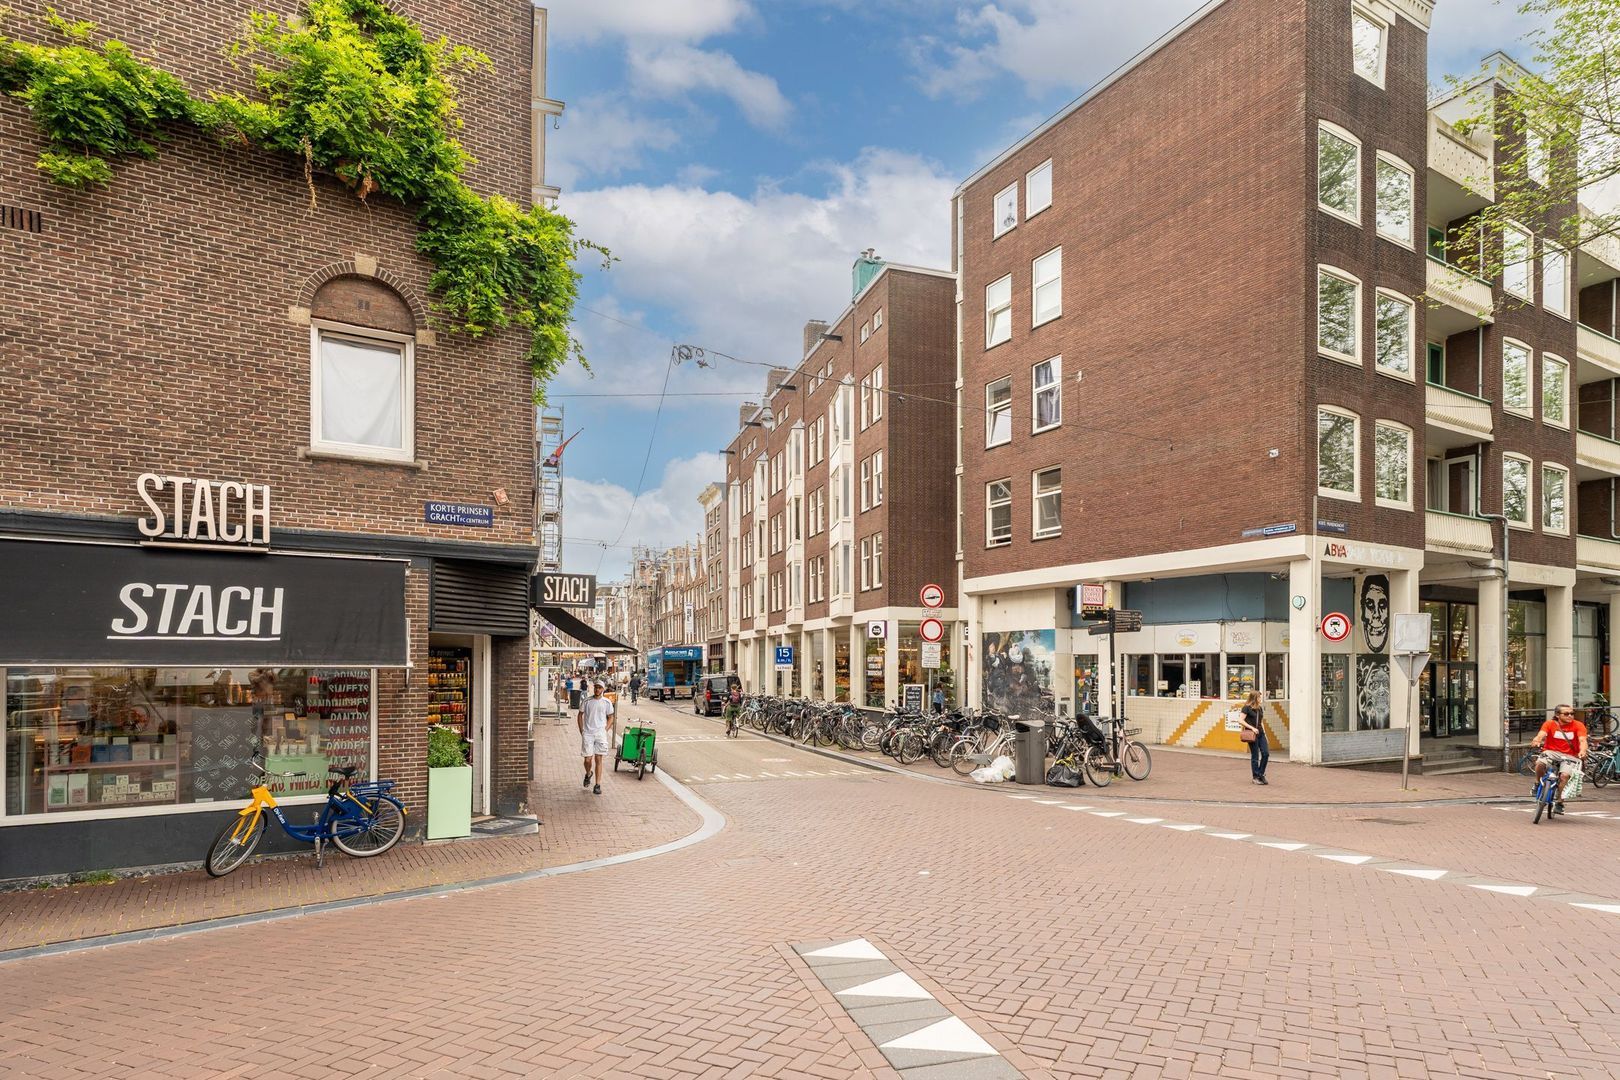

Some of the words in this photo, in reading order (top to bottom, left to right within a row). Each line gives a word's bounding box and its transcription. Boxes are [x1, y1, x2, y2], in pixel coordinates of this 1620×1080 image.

[136, 472, 271, 544] STACH
[430, 504, 455, 513] KORTE
[457, 506, 489, 516] PRINSEN
[430, 512, 460, 522] GRACHT
[543, 576, 590, 603] STACH
[111, 582, 284, 635] STACH
[778, 648, 790, 658] 15
[328, 684, 369, 698] SWEETS
[306, 697, 369, 712] SANDWICHES
[330, 712, 369, 726] PANTRY
[328, 726, 369, 739] SALADS
